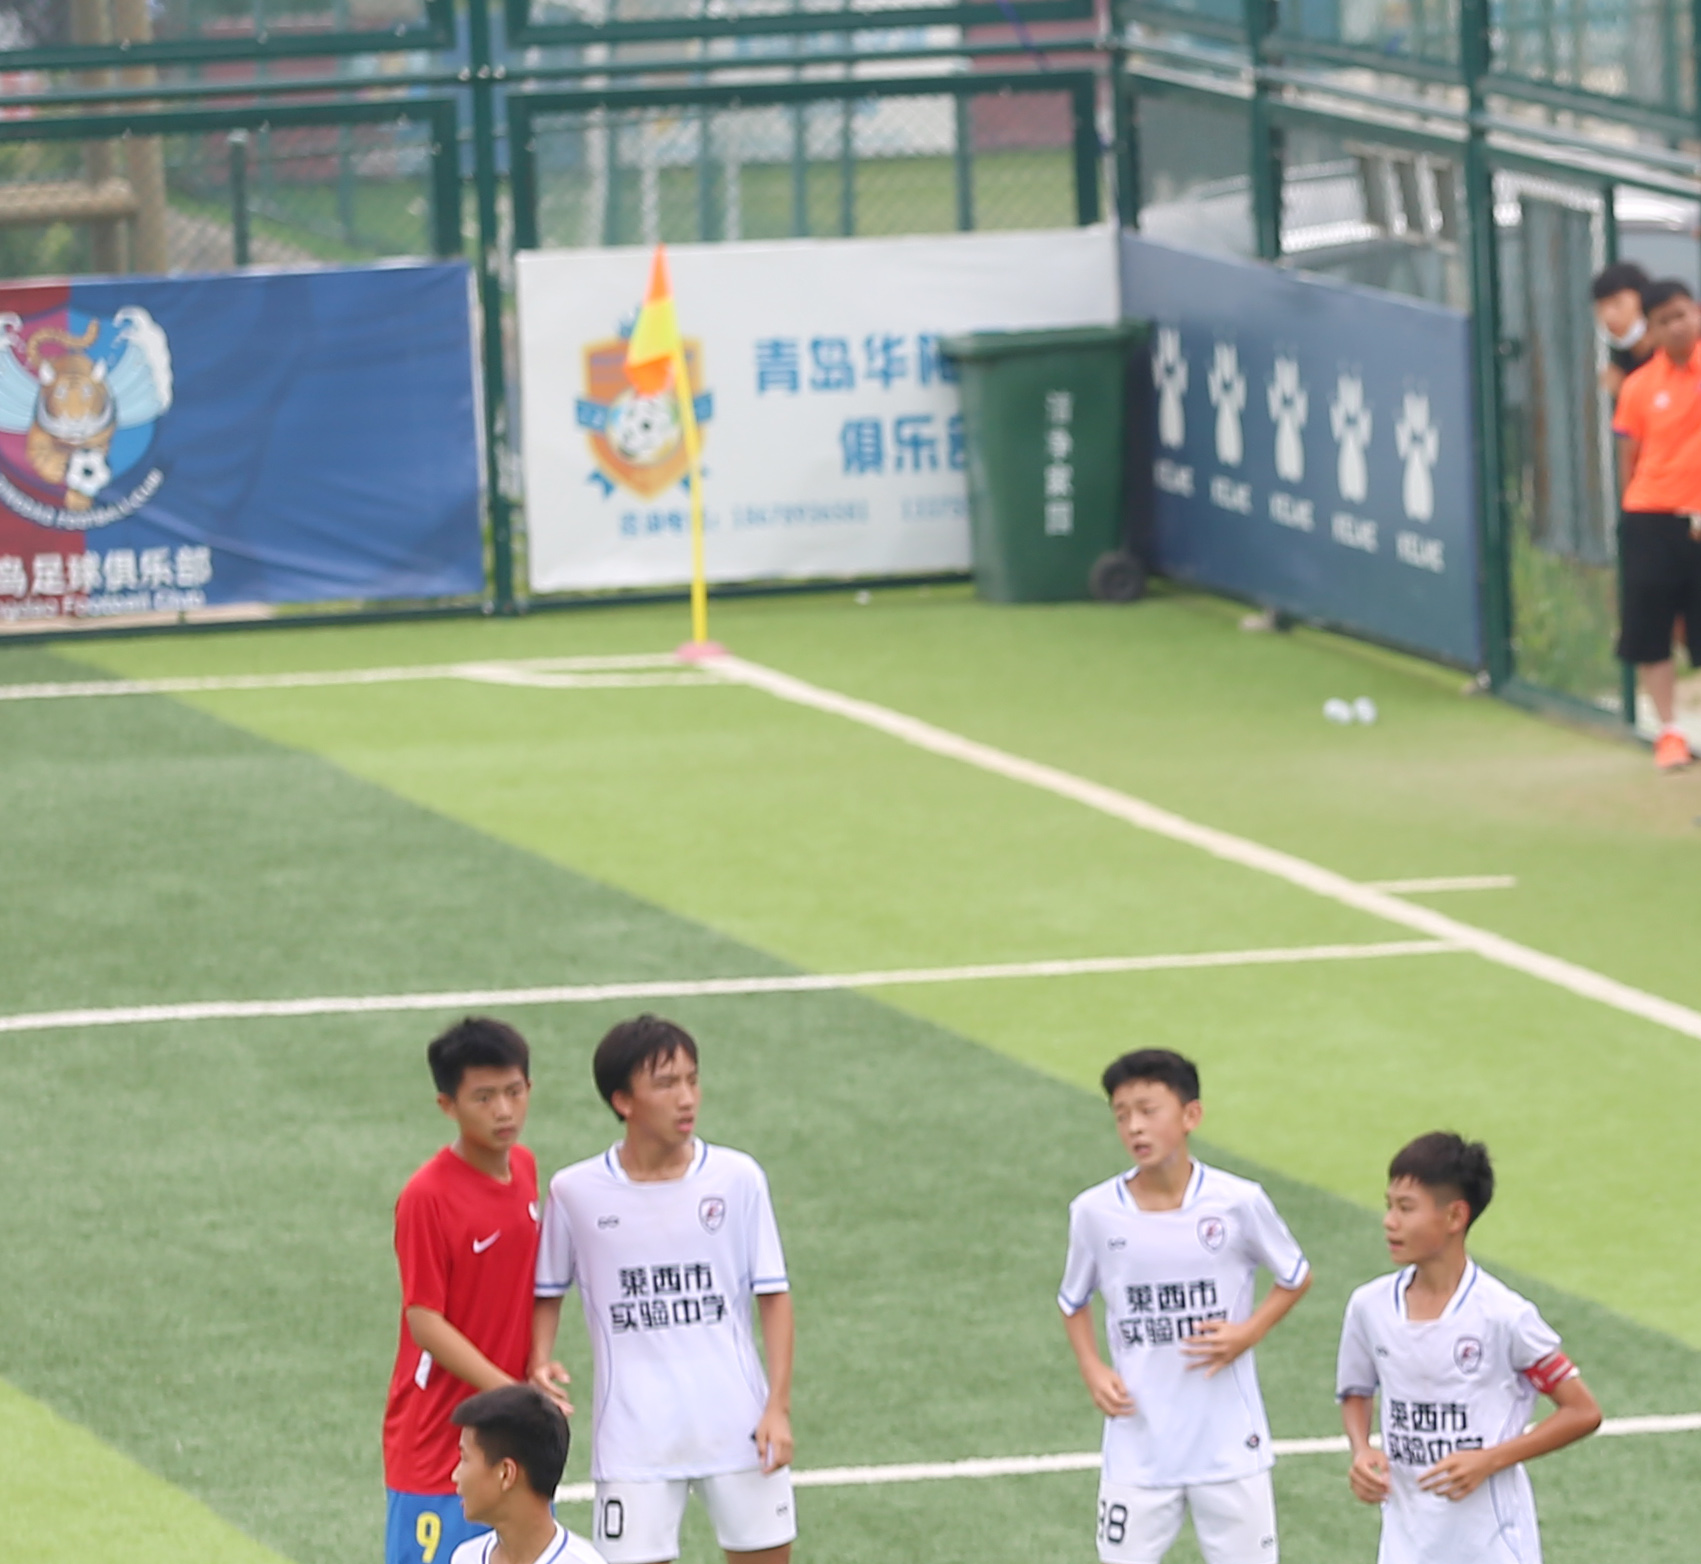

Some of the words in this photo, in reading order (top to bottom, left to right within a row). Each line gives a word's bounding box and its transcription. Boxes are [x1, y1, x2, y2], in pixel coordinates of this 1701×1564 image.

[619, 1263, 713, 1298] 莱西市
[1126, 1280, 1217, 1313] 莱西市
[609, 1295, 728, 1335] 实验中学
[1390, 1398, 1468, 1432] 莱西市
[416, 1512, 442, 1564] 9
